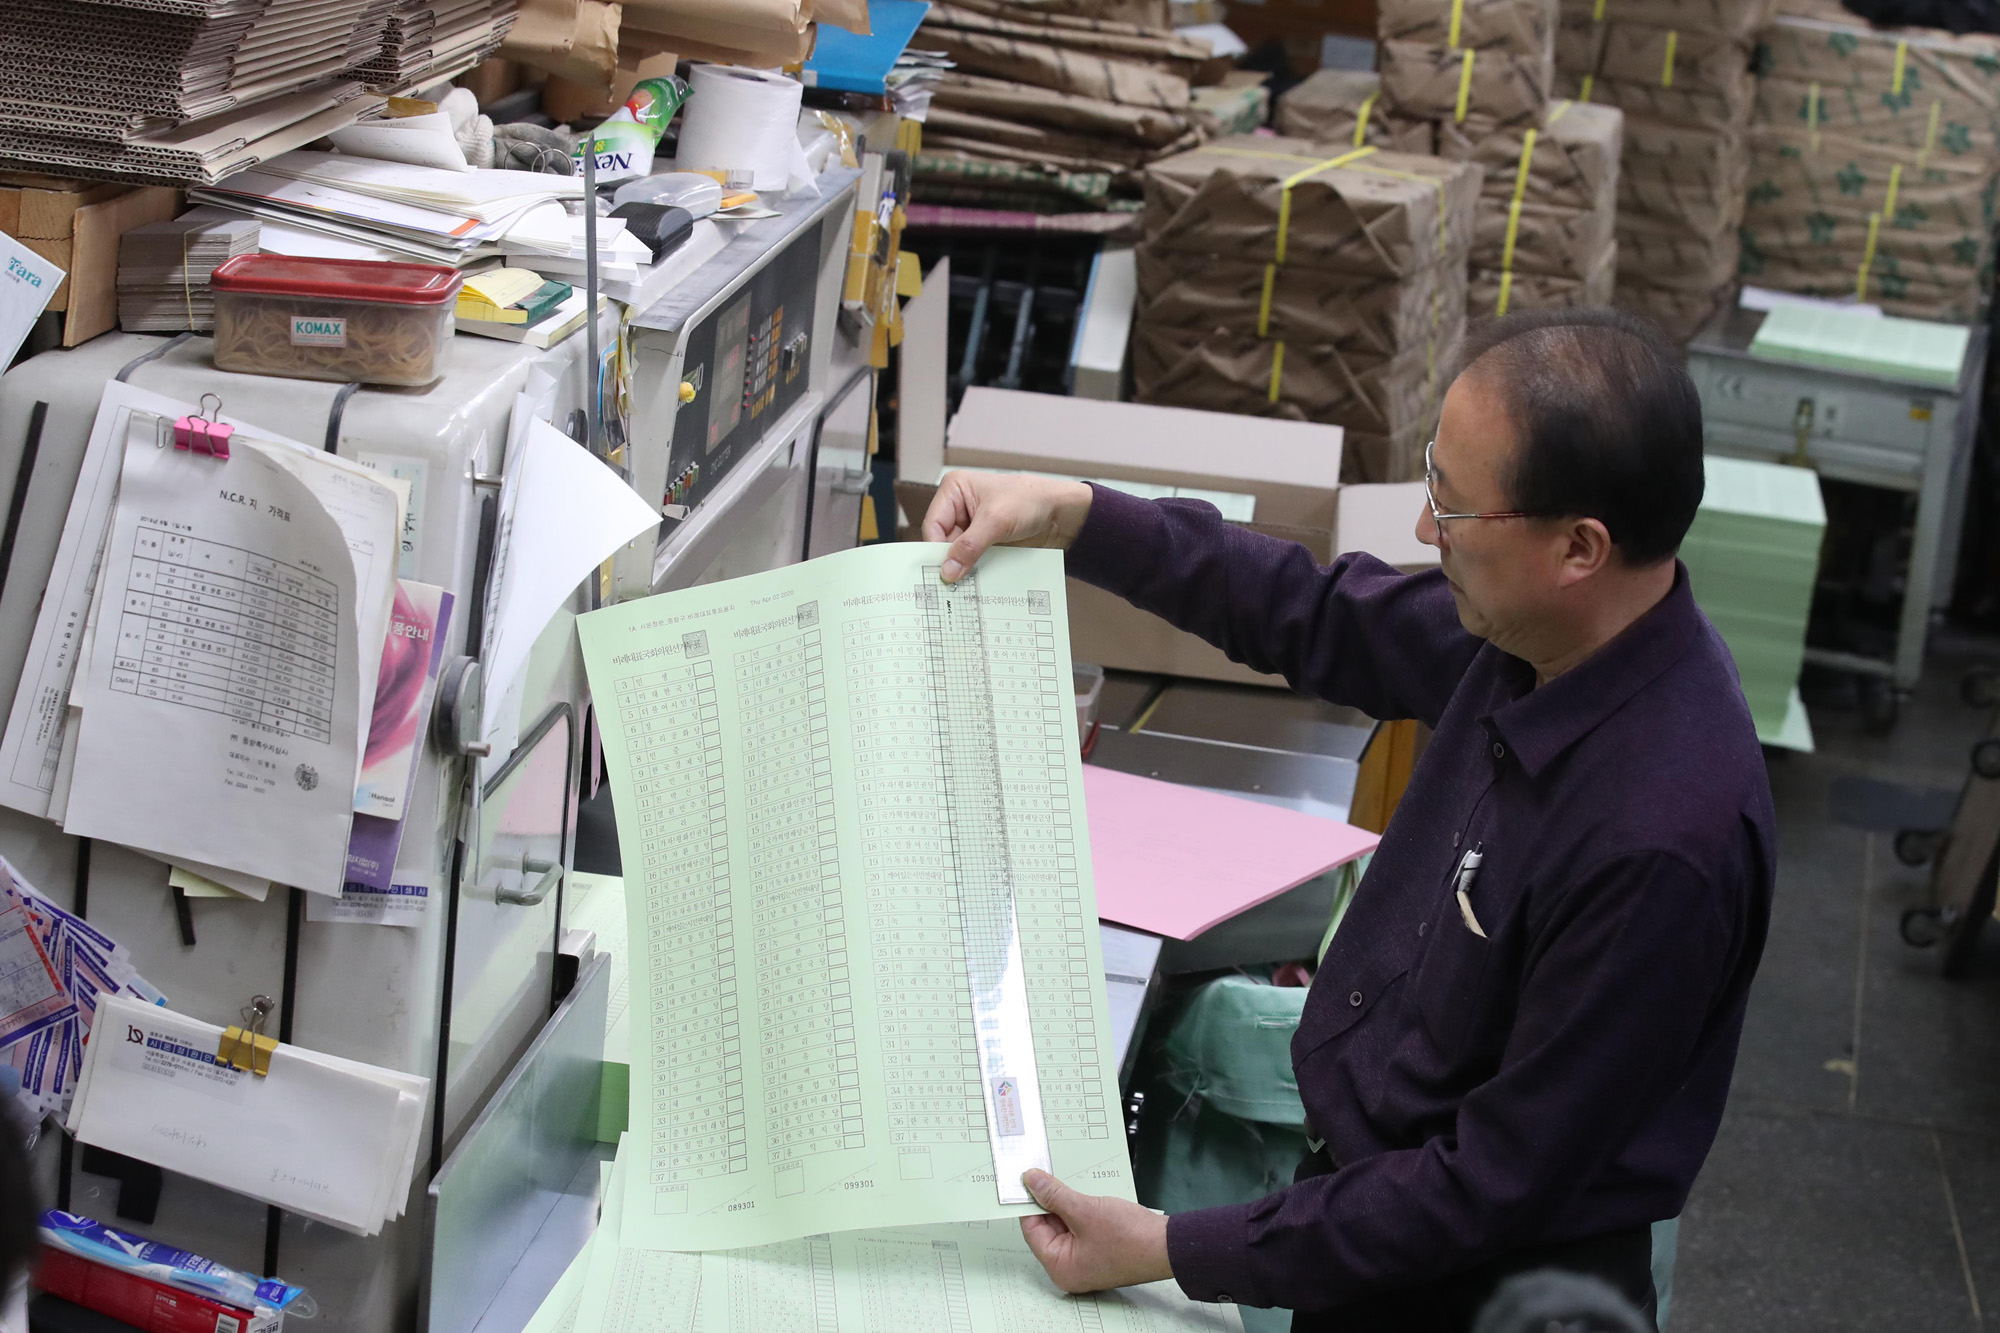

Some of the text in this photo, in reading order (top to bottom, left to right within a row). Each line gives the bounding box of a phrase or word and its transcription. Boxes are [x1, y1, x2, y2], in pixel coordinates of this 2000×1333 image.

[8, 256, 42, 288] Tara
[295, 321, 341, 335] KOMAX
[219, 490, 291, 522] N.C.R. 지 가격표
[780, 589, 794, 599] 2020
[389, 621, 430, 643] 품안내
[850, 638, 856, 646] 4
[851, 653, 857, 661] 5
[852, 667, 859, 675] 6
[622, 681, 628, 690] 3
[854, 681, 860, 689] 7
[625, 696, 631, 704] 4
[855, 695, 861, 704] 8
[627, 711, 634, 719] 5
[856, 710, 863, 719] 9
[630, 725, 637, 734] 6
[856, 724, 866, 733] 10
[633, 740, 639, 749] 7
[858, 739, 867, 748] 11
[636, 755, 642, 763] 8
[859, 754, 869, 763] 12
[860, 769, 870, 777] 13
[862, 783, 872, 792] 14
[371, 793, 396, 803] Hansol
[863, 798, 873, 807] 15
[864, 813, 875, 821] 16
[866, 828, 875, 837] 17
[867, 843, 877, 852] 18
[868, 858, 879, 867] 19
[869, 873, 880, 882] 20
[871, 888, 881, 897] 21
[872, 903, 883, 911] 22
[874, 917, 885, 927] 23
[875, 933, 886, 942] 24
[876, 948, 888, 957] 25
[878, 963, 889, 972] 26
[879, 978, 890, 988] 27
[881, 993, 892, 1003] 28
[883, 1009, 893, 1018] 29
[884, 1025, 895, 1033] 30
[885, 1040, 896, 1048] 31
[887, 1056, 898, 1064] 32
[889, 1071, 900, 1079] 33
[890, 1086, 901, 1094] 34
[892, 1101, 903, 1109] 35
[893, 1117, 904, 1125] 36
[895, 1132, 905, 1140] 37
[656, 1146, 666, 1154] 35
[655, 1160, 666, 1168] 36
[655, 1173, 665, 1181] 37
[971, 1174, 996, 1183] 10930
[1092, 1169, 1121, 1179] 119301
[844, 1179, 875, 1190] 099301
[728, 1201, 755, 1212] 089301
